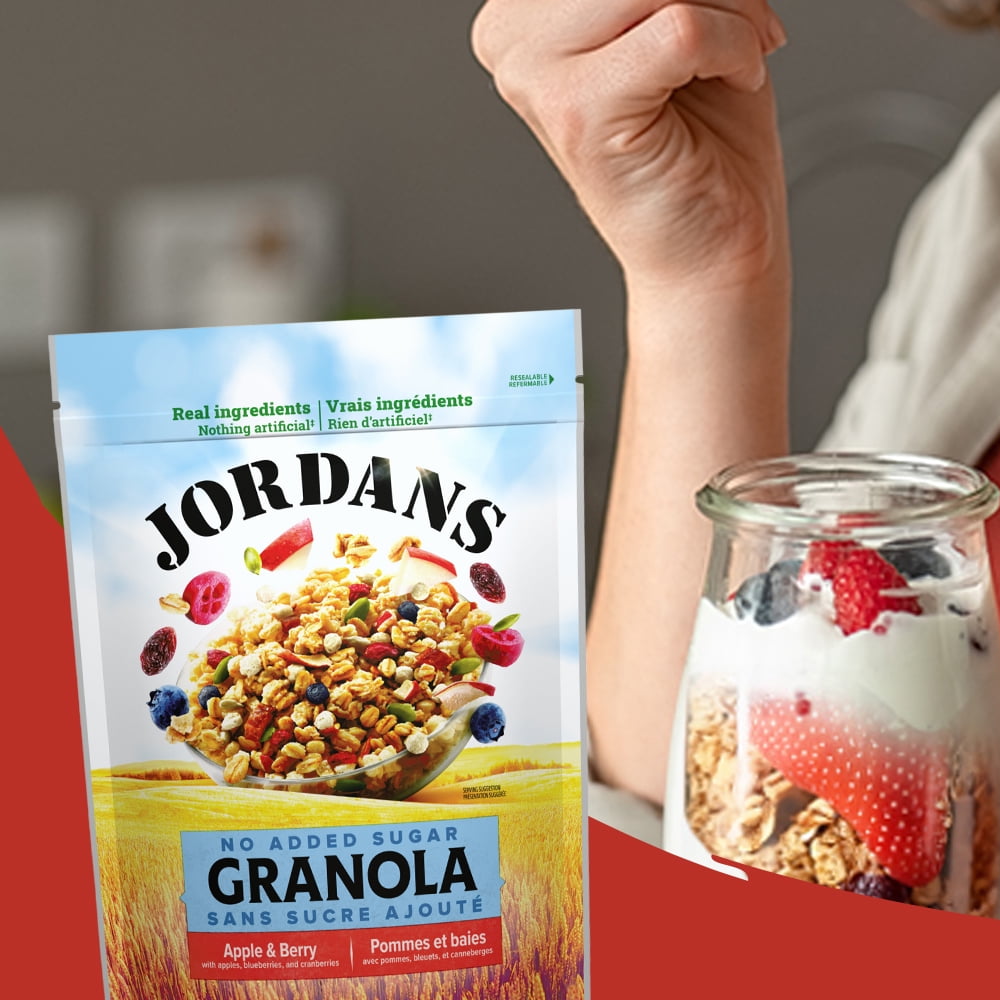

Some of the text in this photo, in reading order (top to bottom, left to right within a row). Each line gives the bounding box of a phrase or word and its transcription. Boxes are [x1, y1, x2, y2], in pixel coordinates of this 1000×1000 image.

[510, 373, 548, 381] RESEALABLE
[172, 402, 311, 421] Real ingredients
[326, 394, 473, 413] Vrais ingrédients
[198, 423, 251, 436] Nothing
[327, 416, 358, 430] Rien
[144, 451, 507, 572] JORDANS
[220, 826, 459, 851] NO ADDED SUGAR
[207, 846, 479, 906] GRANOLA
[207, 895, 484, 926] SANS SUCRE AJOUTÉ
[223, 942, 317, 962] Apple & Berry
[370, 930, 487, 954] Pommes et baies
[201, 958, 340, 970] with apples, blueberries, and cranberries
[362, 957, 379, 966] avec
[380, 954, 412, 966] pommes,
[442, 951, 450, 959] et
[450, 946, 494, 959] canneberges
